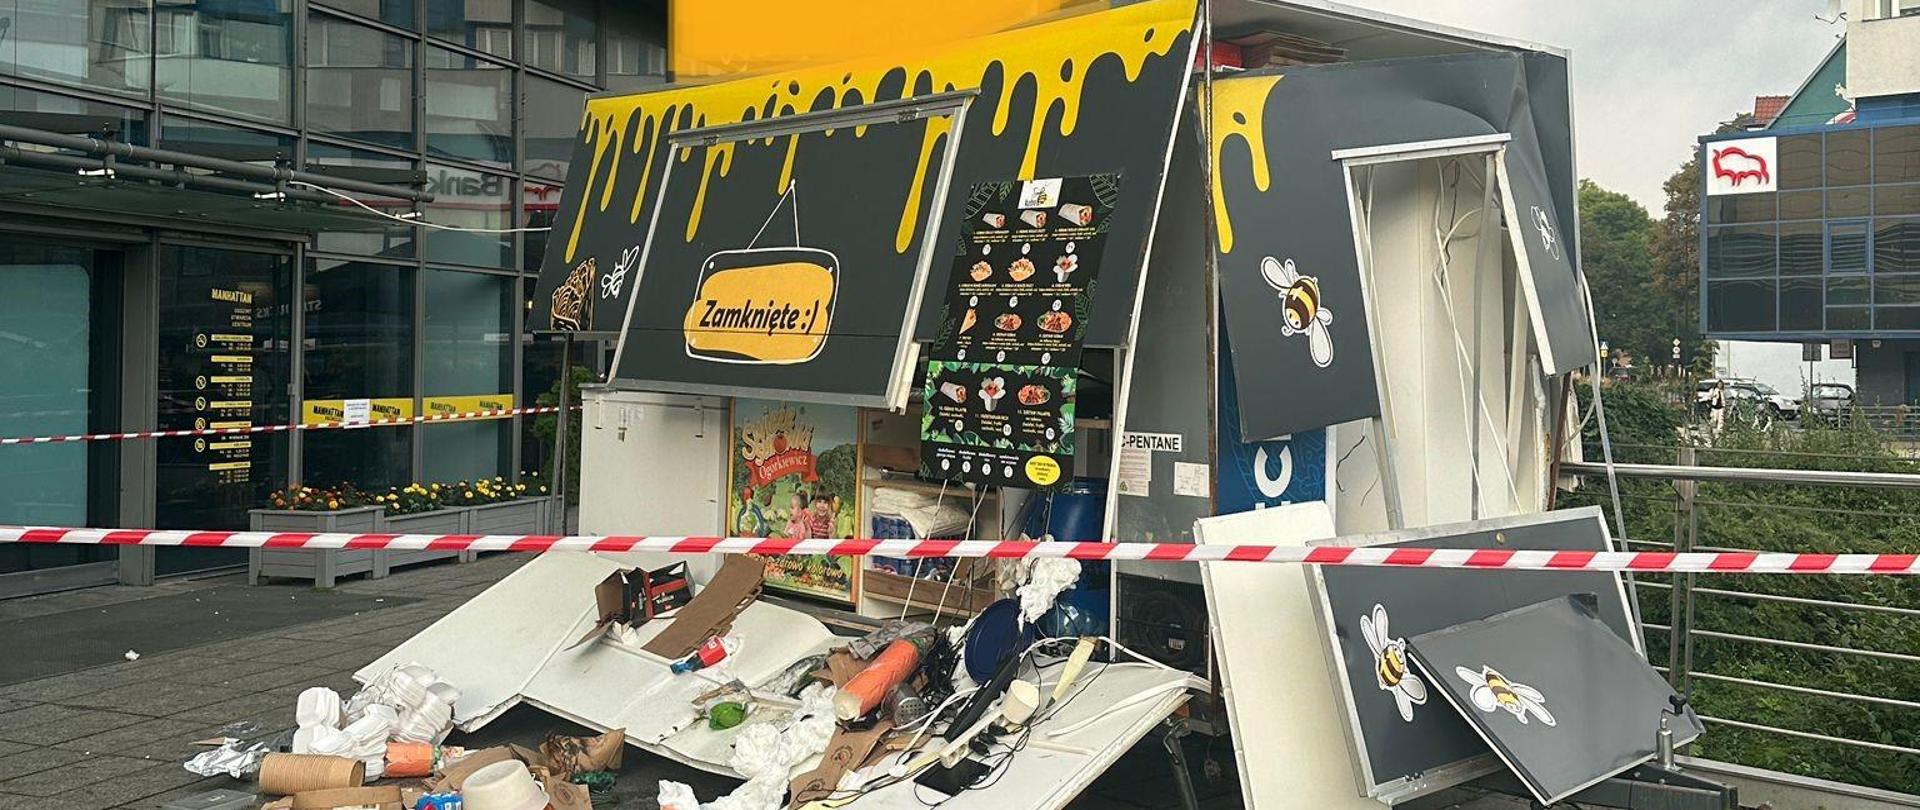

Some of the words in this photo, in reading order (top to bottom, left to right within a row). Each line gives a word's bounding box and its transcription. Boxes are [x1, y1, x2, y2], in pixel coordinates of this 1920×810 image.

[211, 288, 252, 304] MANHATTAN
[699, 300, 800, 336] Zamknięte
[313, 405, 344, 418] MANHATTAN
[372, 404, 401, 415] MANHATTAN
